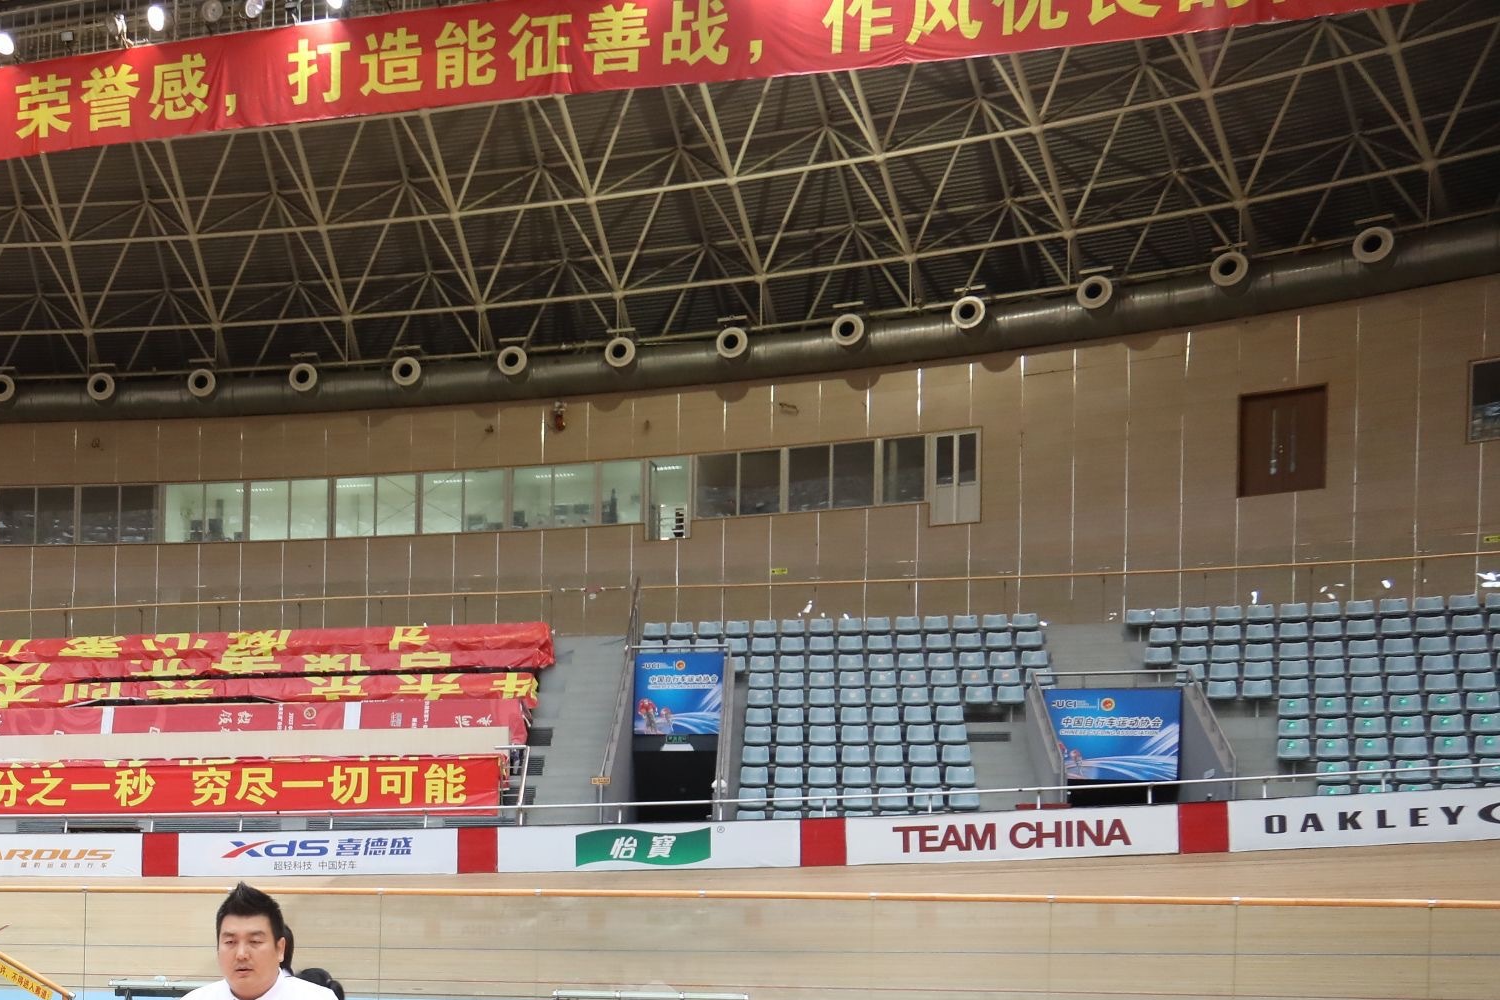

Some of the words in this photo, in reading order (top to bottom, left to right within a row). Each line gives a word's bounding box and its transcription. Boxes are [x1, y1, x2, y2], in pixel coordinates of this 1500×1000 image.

[15, 53, 237, 137] 荣誉感，
[287, 4, 763, 104] 打造能征善战，
[1056, 699, 1078, 708] UCI
[1061, 716, 1163, 729] 中国自行车运动协会
[191, 763, 467, 807] 穷尽一切可能
[1264, 805, 1465, 835] OAKLEY
[336, 836, 414, 856] 喜德盛
[609, 835, 677, 859] 怡寶
[892, 822, 997, 853] TEAM
[1009, 818, 1133, 850] CHINA
[273, 861, 313, 871] 超轻科技
[318, 860, 357, 871] 中国好车
